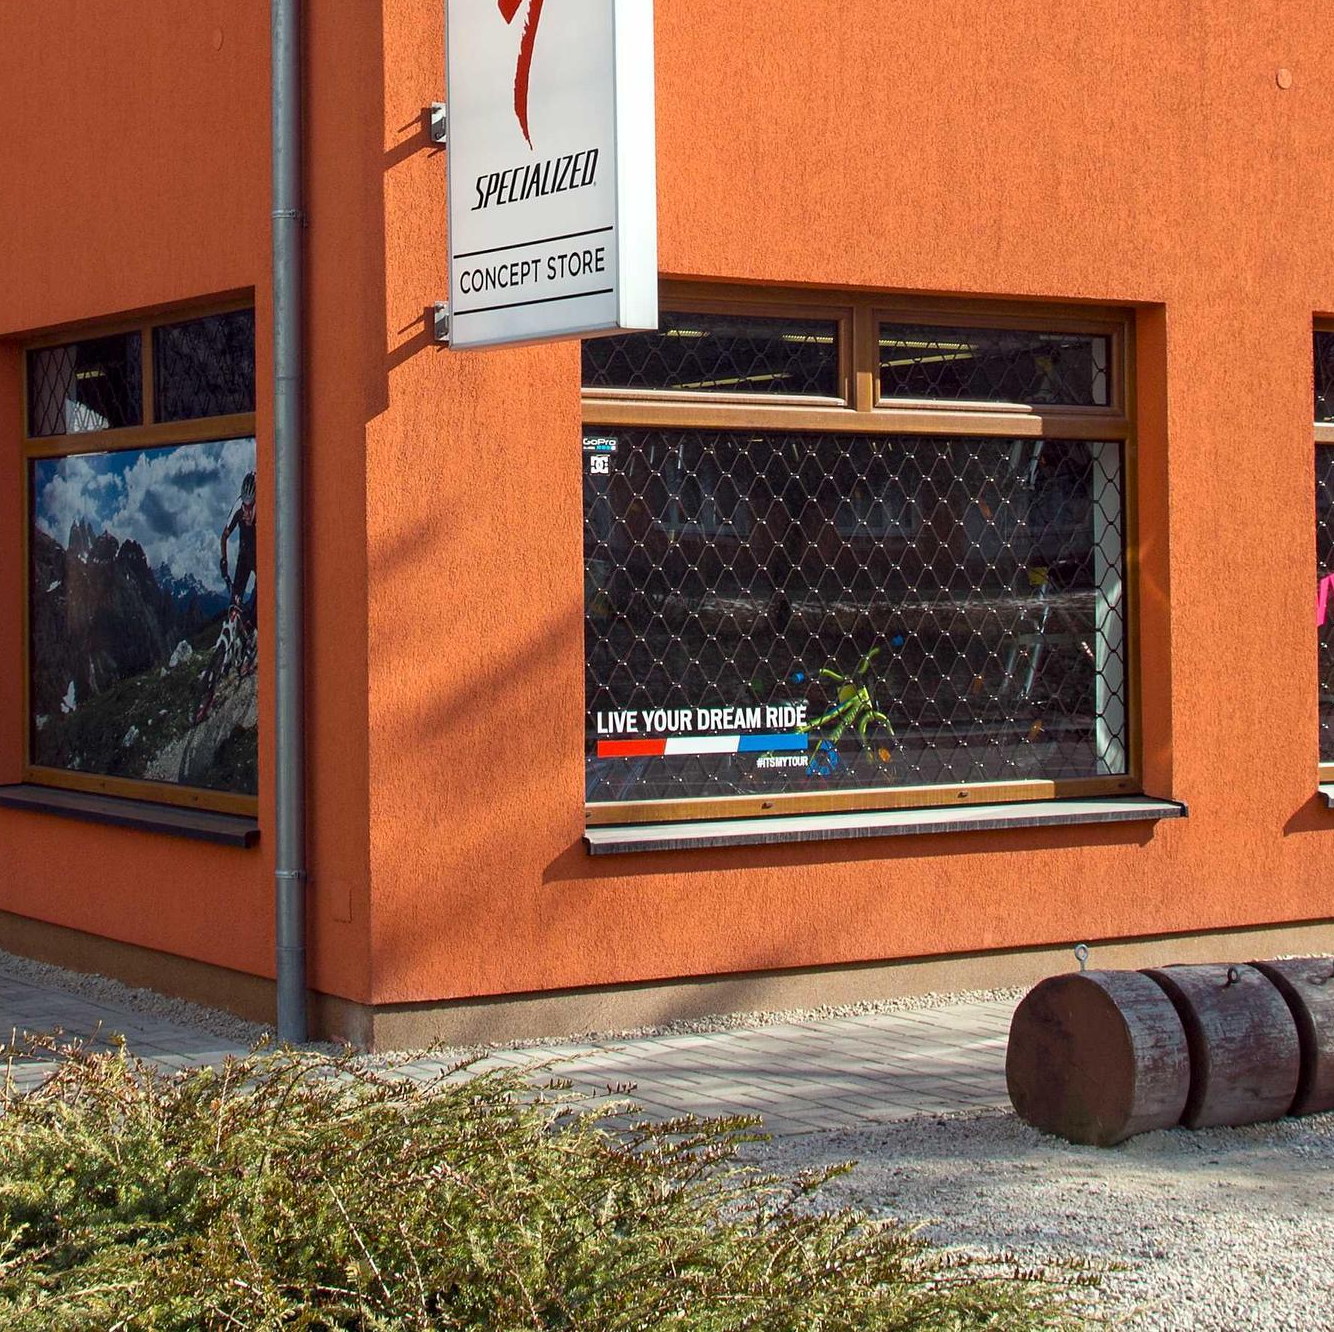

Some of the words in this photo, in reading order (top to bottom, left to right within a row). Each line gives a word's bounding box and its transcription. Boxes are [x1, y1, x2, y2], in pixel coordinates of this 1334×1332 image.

[470, 148, 599, 211] SPECIALIZED
[459, 258, 542, 294] CONCEPT
[547, 247, 605, 280] STORE
[583, 438, 616, 446] GoPro
[597, 710, 639, 734] LIVE
[642, 709, 693, 733] YOUR
[697, 706, 762, 731] DREAM
[766, 704, 808, 728] RIDE
[756, 755, 809, 768] #ITSMYTOUR
